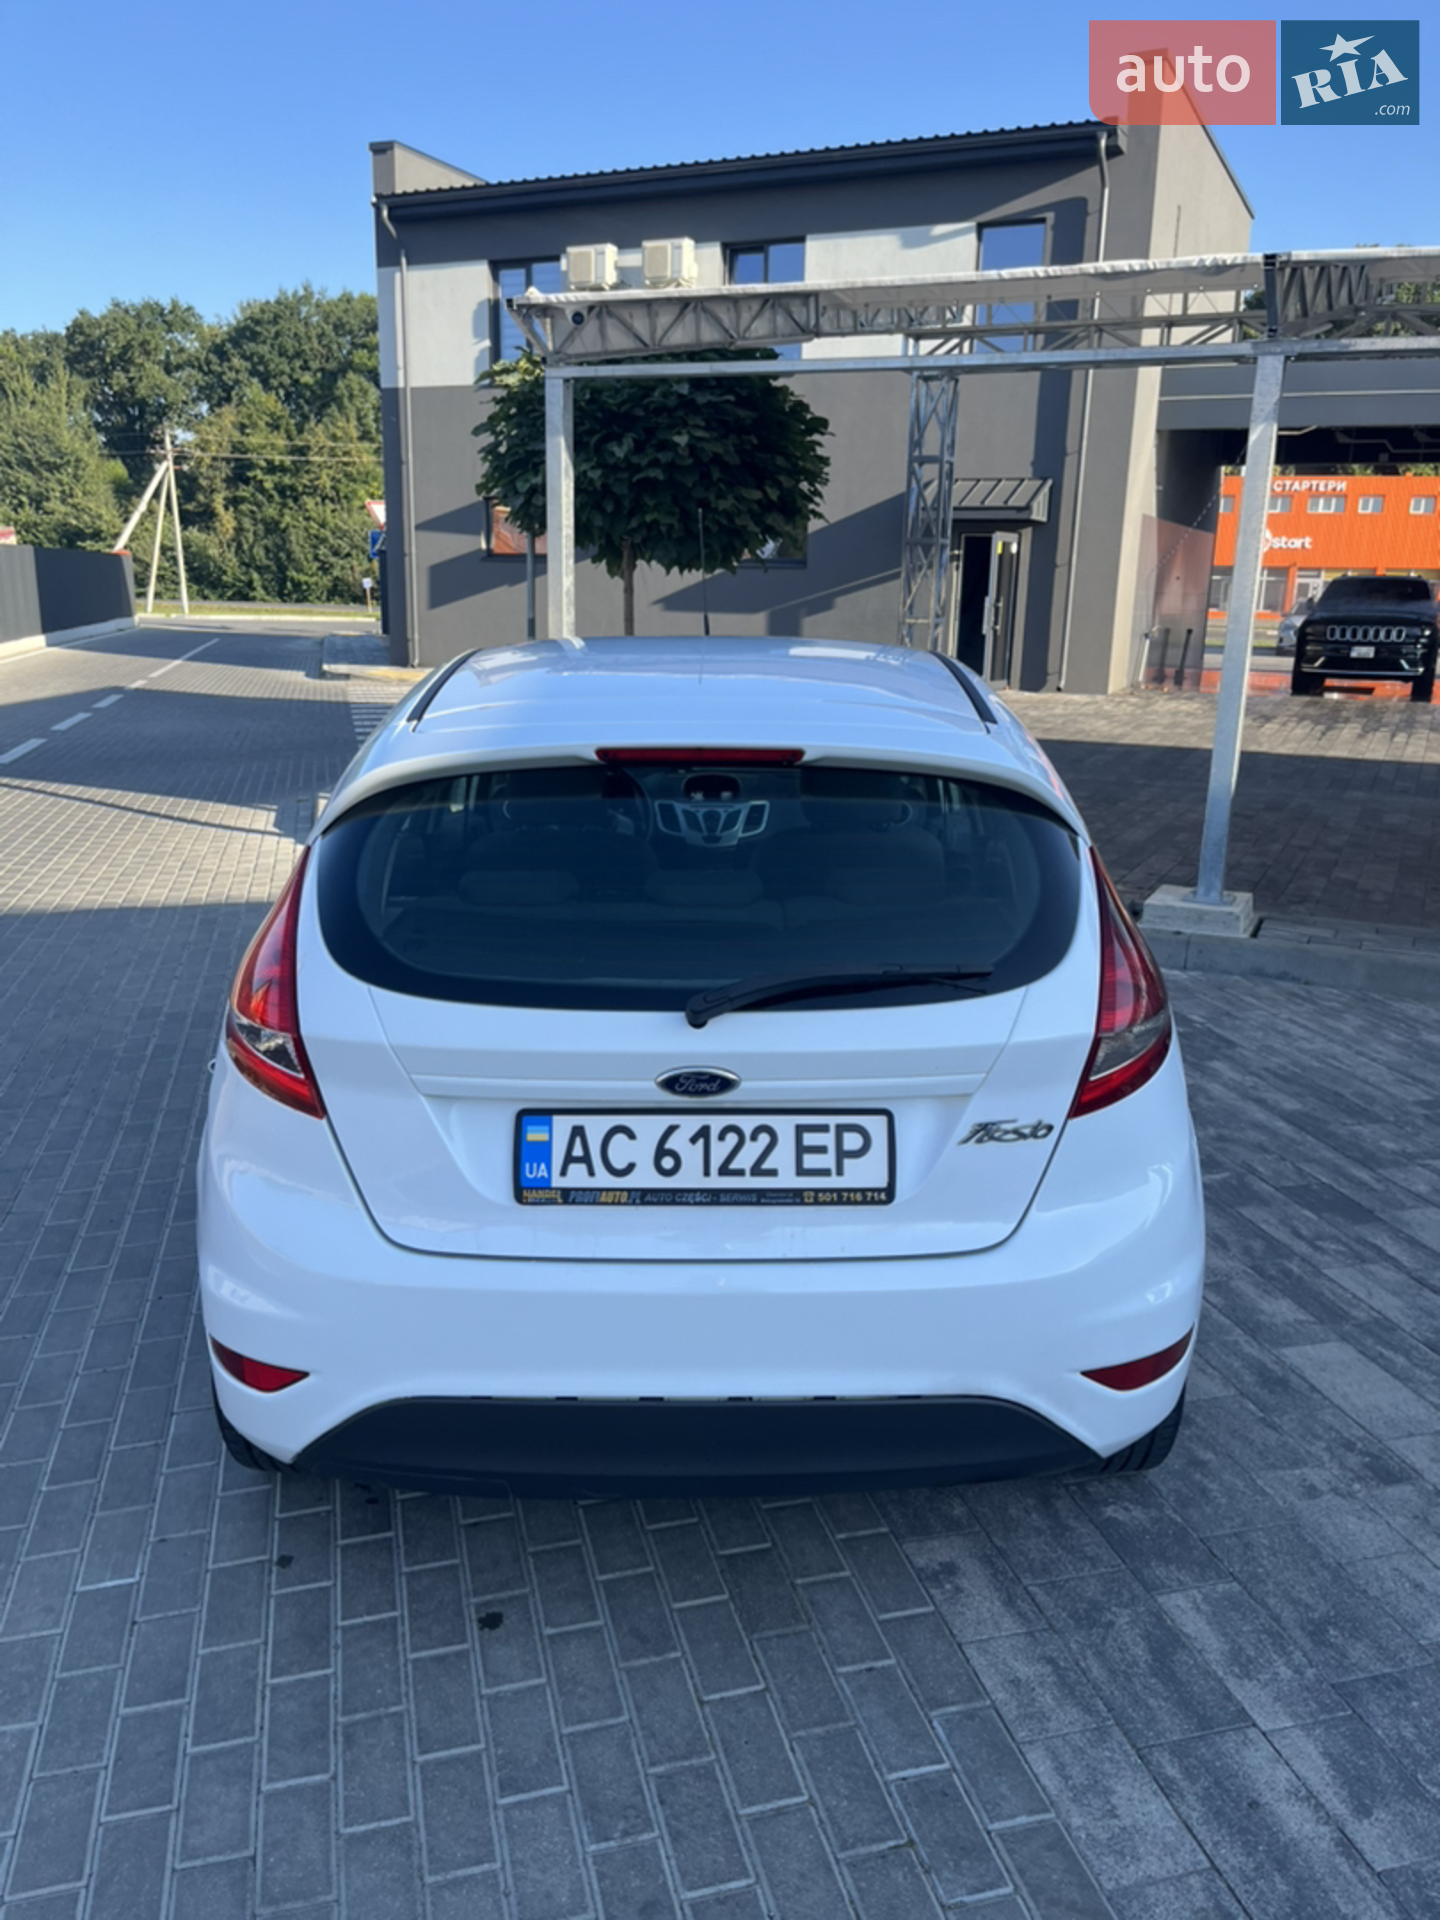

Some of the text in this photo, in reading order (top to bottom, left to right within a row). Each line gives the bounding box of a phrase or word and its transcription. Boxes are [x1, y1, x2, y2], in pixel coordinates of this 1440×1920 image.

[1273, 480, 1347, 492] СТАРТЕРИ
[675, 1073, 721, 1092] Ford
[559, 1123, 873, 1178] AC 6122 EP
[525, 1162, 549, 1179] UA
